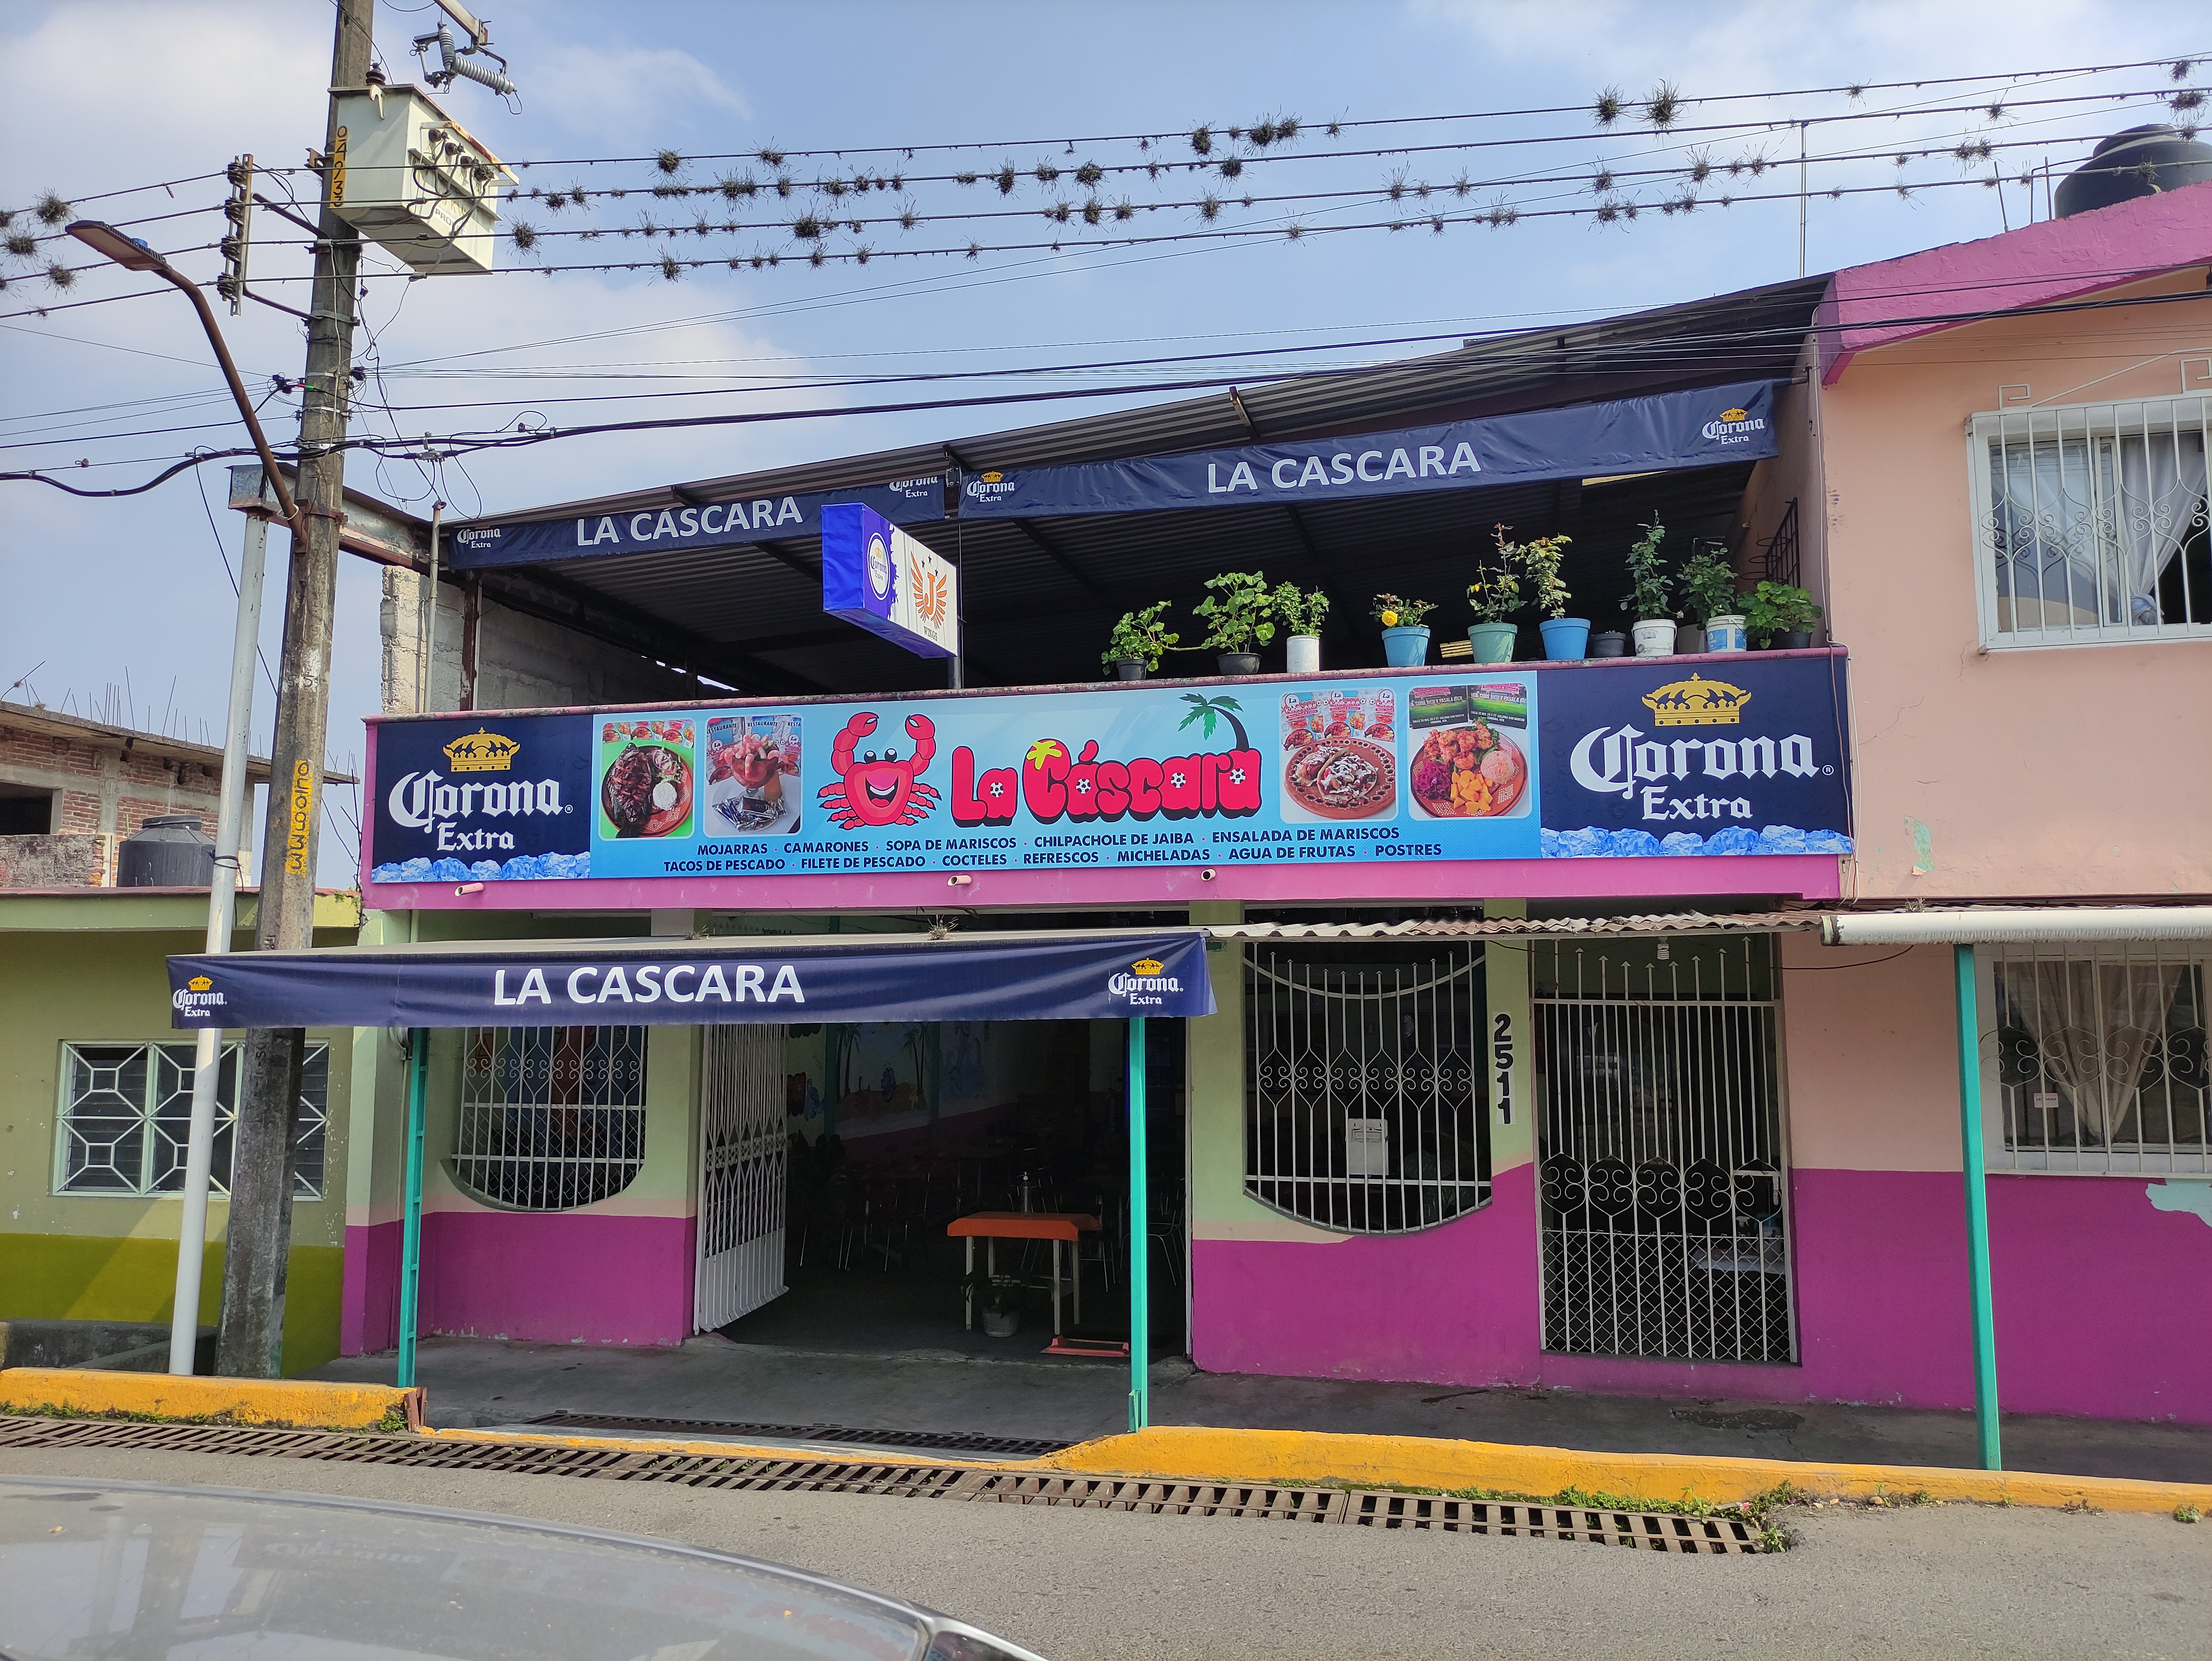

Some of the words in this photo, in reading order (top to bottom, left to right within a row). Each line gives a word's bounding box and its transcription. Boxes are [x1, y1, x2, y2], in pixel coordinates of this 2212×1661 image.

[1702, 418, 1765, 440] Corona
[1720, 434, 1749, 445] Extra
[1207, 461, 1259, 495] LA
[1271, 442, 1482, 489] CASCARA
[889, 476, 938, 492] Corona
[966, 480, 1016, 498] Corona
[905, 489, 928, 498] Extra
[979, 494, 1002, 502] Extra
[577, 517, 620, 546] LA
[630, 496, 804, 542] CASCARA
[457, 528, 502, 544] Corona
[471, 541, 491, 549] Extra
[871, 555, 887, 575] Corona
[874, 570, 884, 581] Extra
[924, 571, 936, 615] J
[923, 625, 938, 642] WINGS
[1570, 723, 1820, 799] Corona
[951, 745, 1018, 828] La
[1022, 739, 1262, 824] Cáscara
[388, 769, 564, 833] Corona
[1640, 785, 1753, 820] Extra
[437, 822, 515, 852] Extra
[1034, 834, 1127, 848] CHILPACHOLE
[1131, 833, 1148, 845] DE
[1152, 832, 1194, 844] JAIBA
[1212, 830, 1293, 843] ENSALADA
[1297, 829, 1316, 841] DE
[1320, 827, 1400, 840] MARISCOS
[697, 843, 768, 855] MOJARRAS
[784, 841, 869, 853] CAMARONES
[885, 840, 921, 852] SOPA
[925, 839, 942, 850] DE
[945, 837, 1017, 850] MARISCOS
[1228, 847, 1272, 860] AGUA
[1276, 847, 1295, 858] DE
[1299, 845, 1355, 858] FRUTAS
[1375, 843, 1442, 856] POSTRES
[801, 858, 840, 869] FILETE
[843, 857, 860, 868] DE
[863, 856, 926, 868] PESCADO
[942, 854, 1007, 866] COCTELES
[1024, 852, 1099, 864] REFRESCOS
[1117, 849, 1210, 862] MICHELADAS
[664, 860, 703, 872] TACOS
[706, 860, 722, 871] DE
[725, 858, 785, 871] PESCADO
[493, 968, 552, 1006] LA
[566, 964, 806, 1004] CASCARA
[1108, 972, 1180, 997] Corona
[173, 988, 225, 1010] Corona
[1129, 993, 1162, 1005] Extra
[184, 1006, 210, 1017] Extra
[1493, 1013, 1514, 1124] 2511
